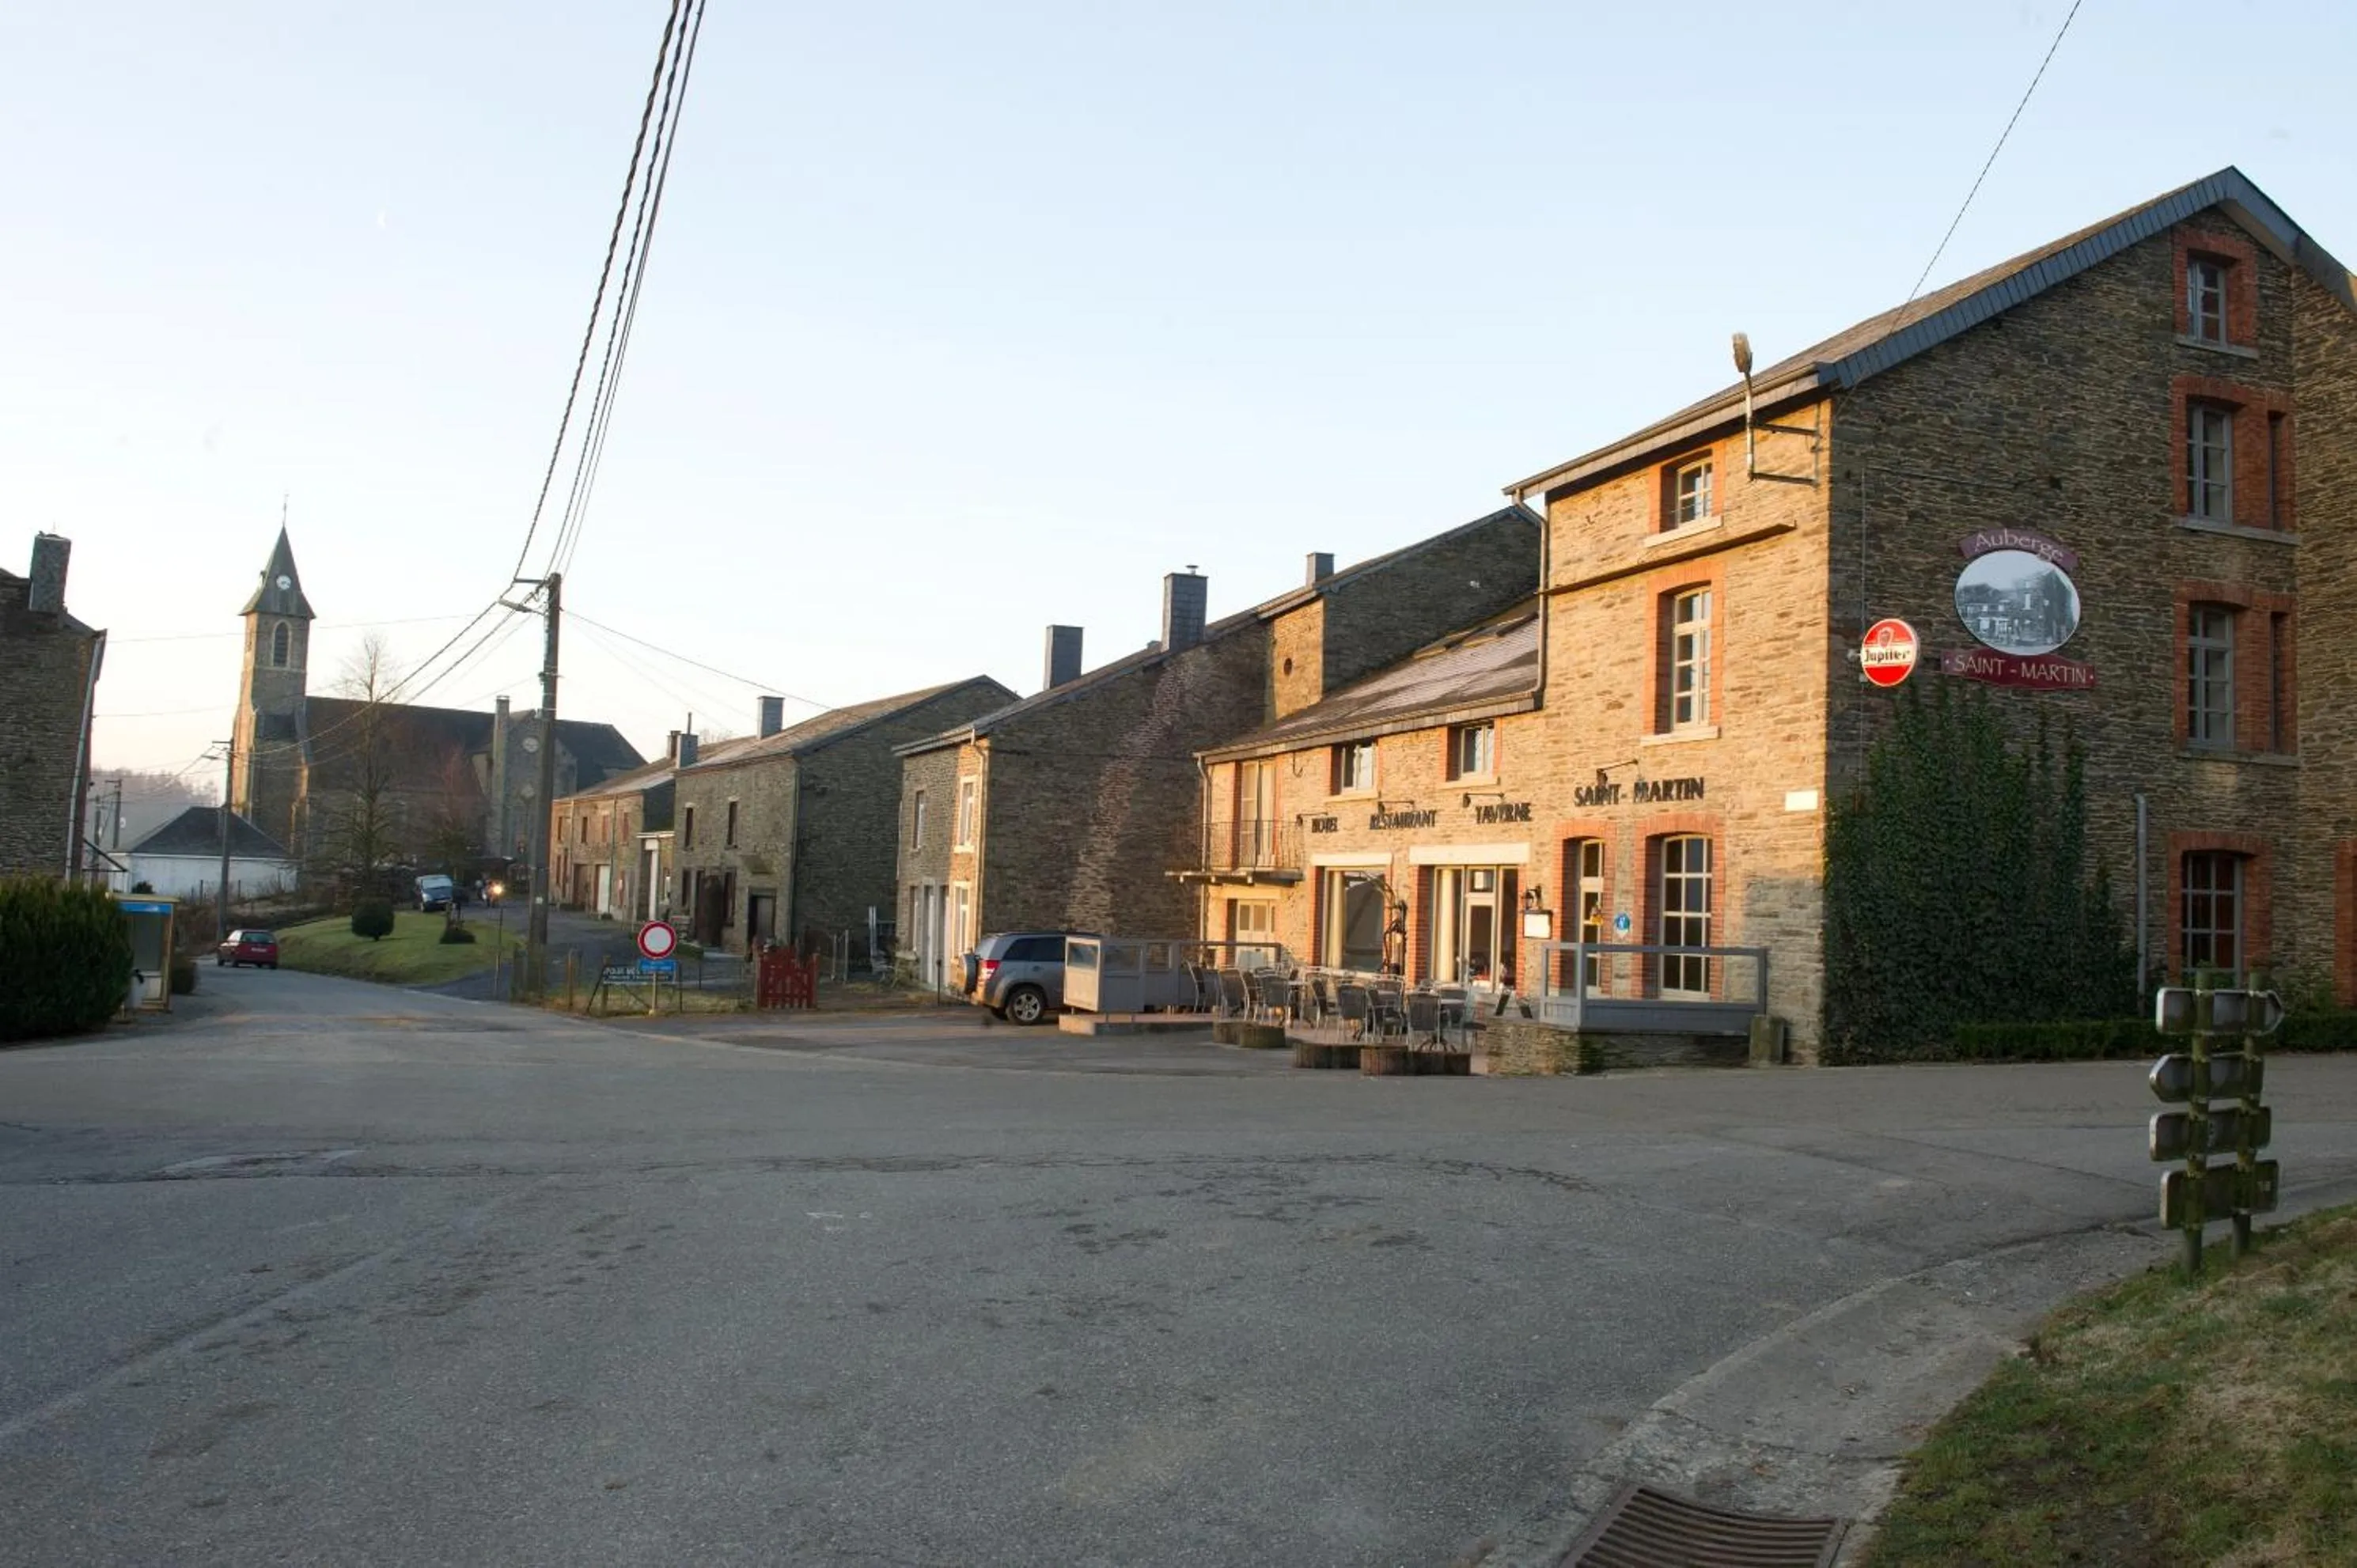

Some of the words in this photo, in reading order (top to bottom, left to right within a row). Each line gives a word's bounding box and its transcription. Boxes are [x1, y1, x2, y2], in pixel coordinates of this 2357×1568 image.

[1974, 528, 2064, 562] Auberge
[1864, 649, 1908, 663] Jupiter
[1475, 802, 1533, 824] TAVERNE
